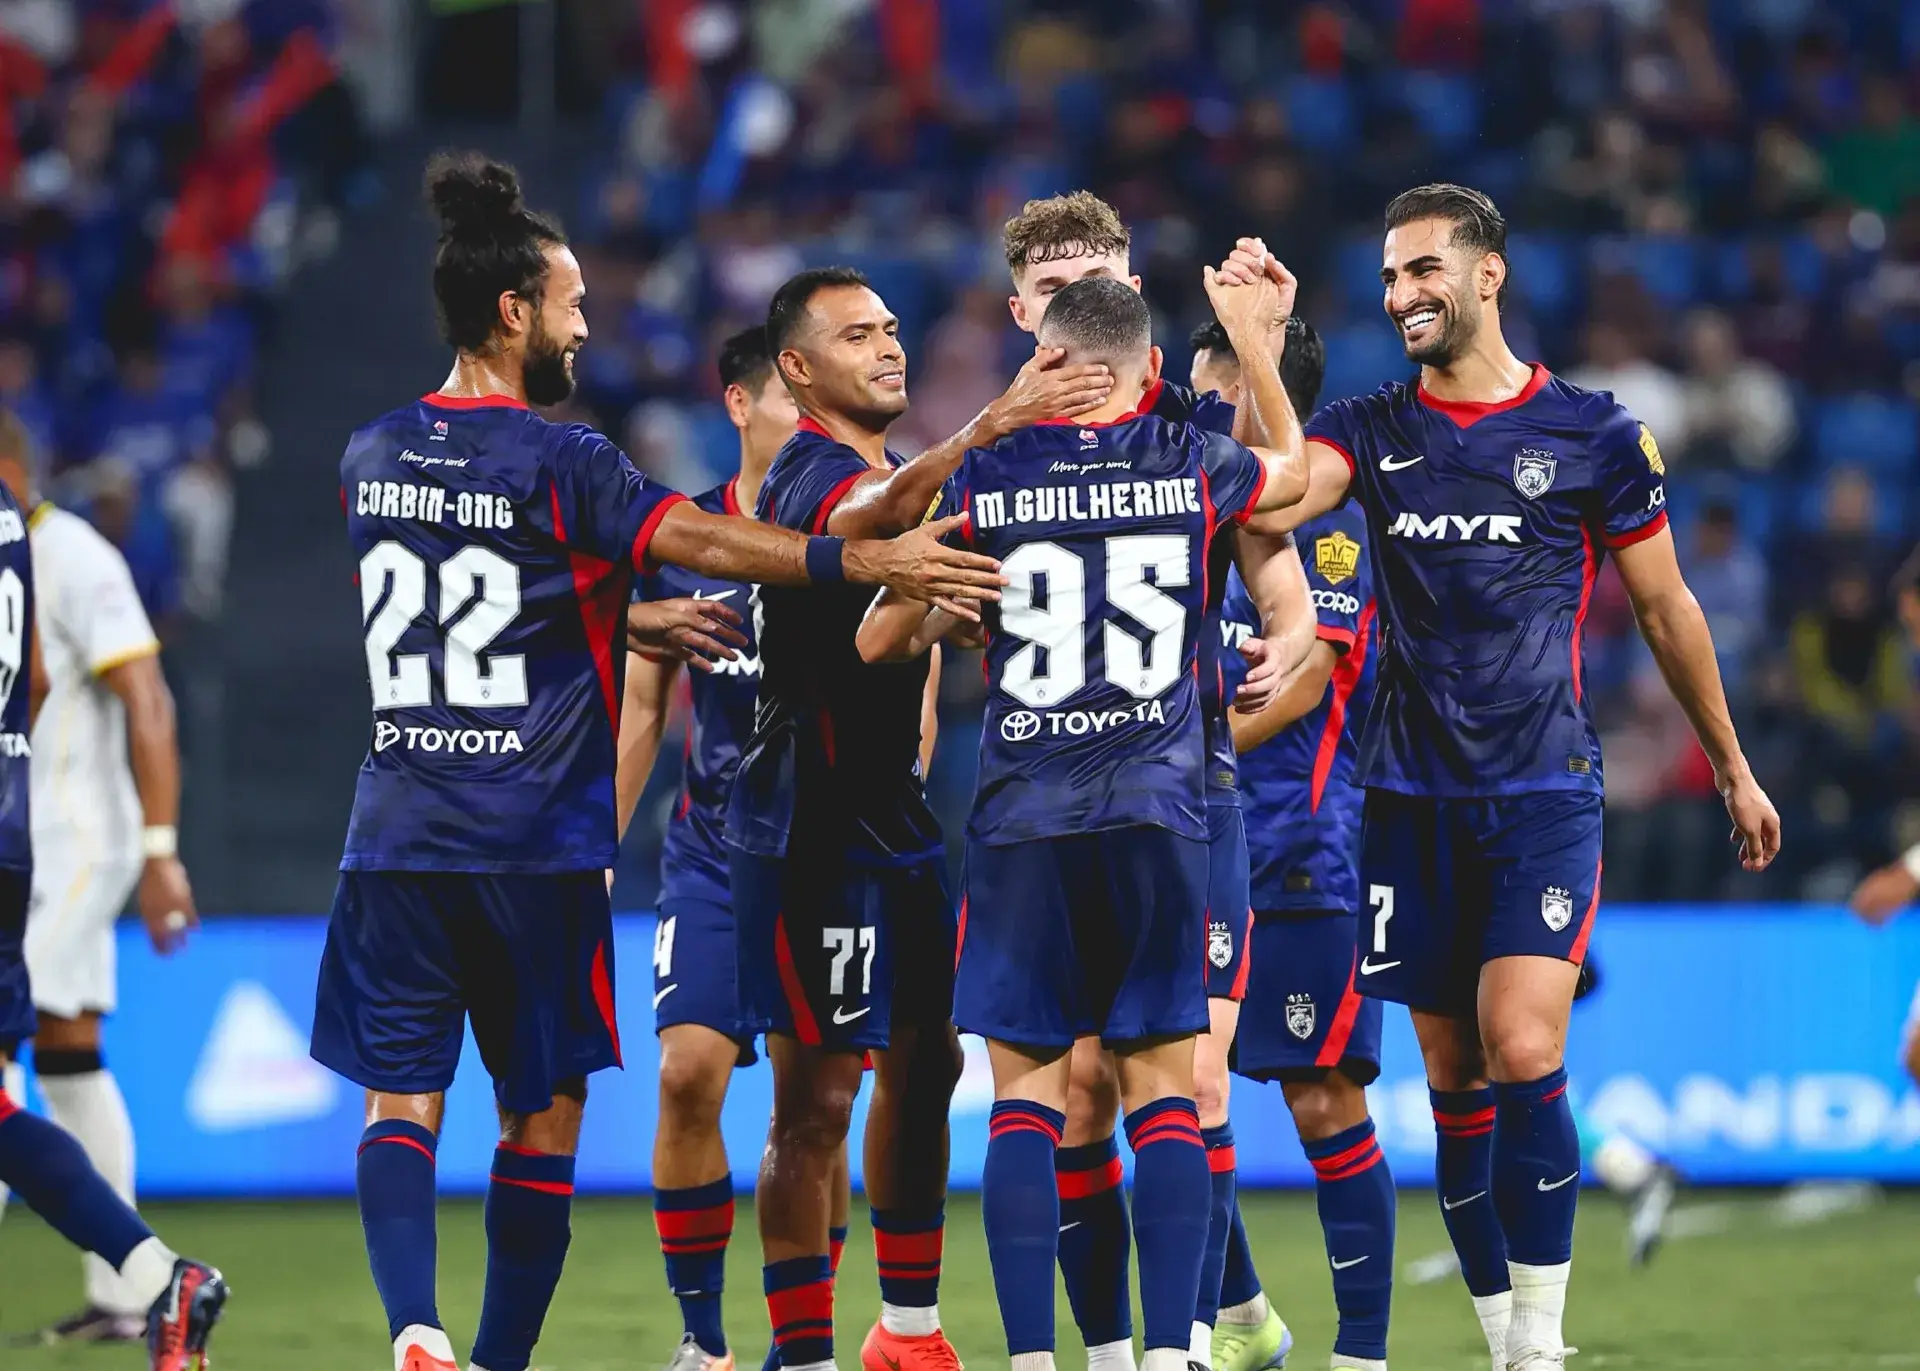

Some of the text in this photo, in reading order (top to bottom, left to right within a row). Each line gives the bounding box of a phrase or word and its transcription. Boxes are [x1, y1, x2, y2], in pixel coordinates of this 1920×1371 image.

[398, 449, 424, 462] Move
[421, 457, 444, 468] your
[1048, 460, 1132, 475] Move your world
[356, 480, 514, 529] CORBIN-ONG
[1387, 512, 1522, 543] JMYR
[359, 539, 529, 711] 22
[999, 534, 1190, 708] 95
[404, 727, 524, 754] TOYOTA
[1369, 883, 1394, 953] 7
[822, 926, 876, 995] 77
